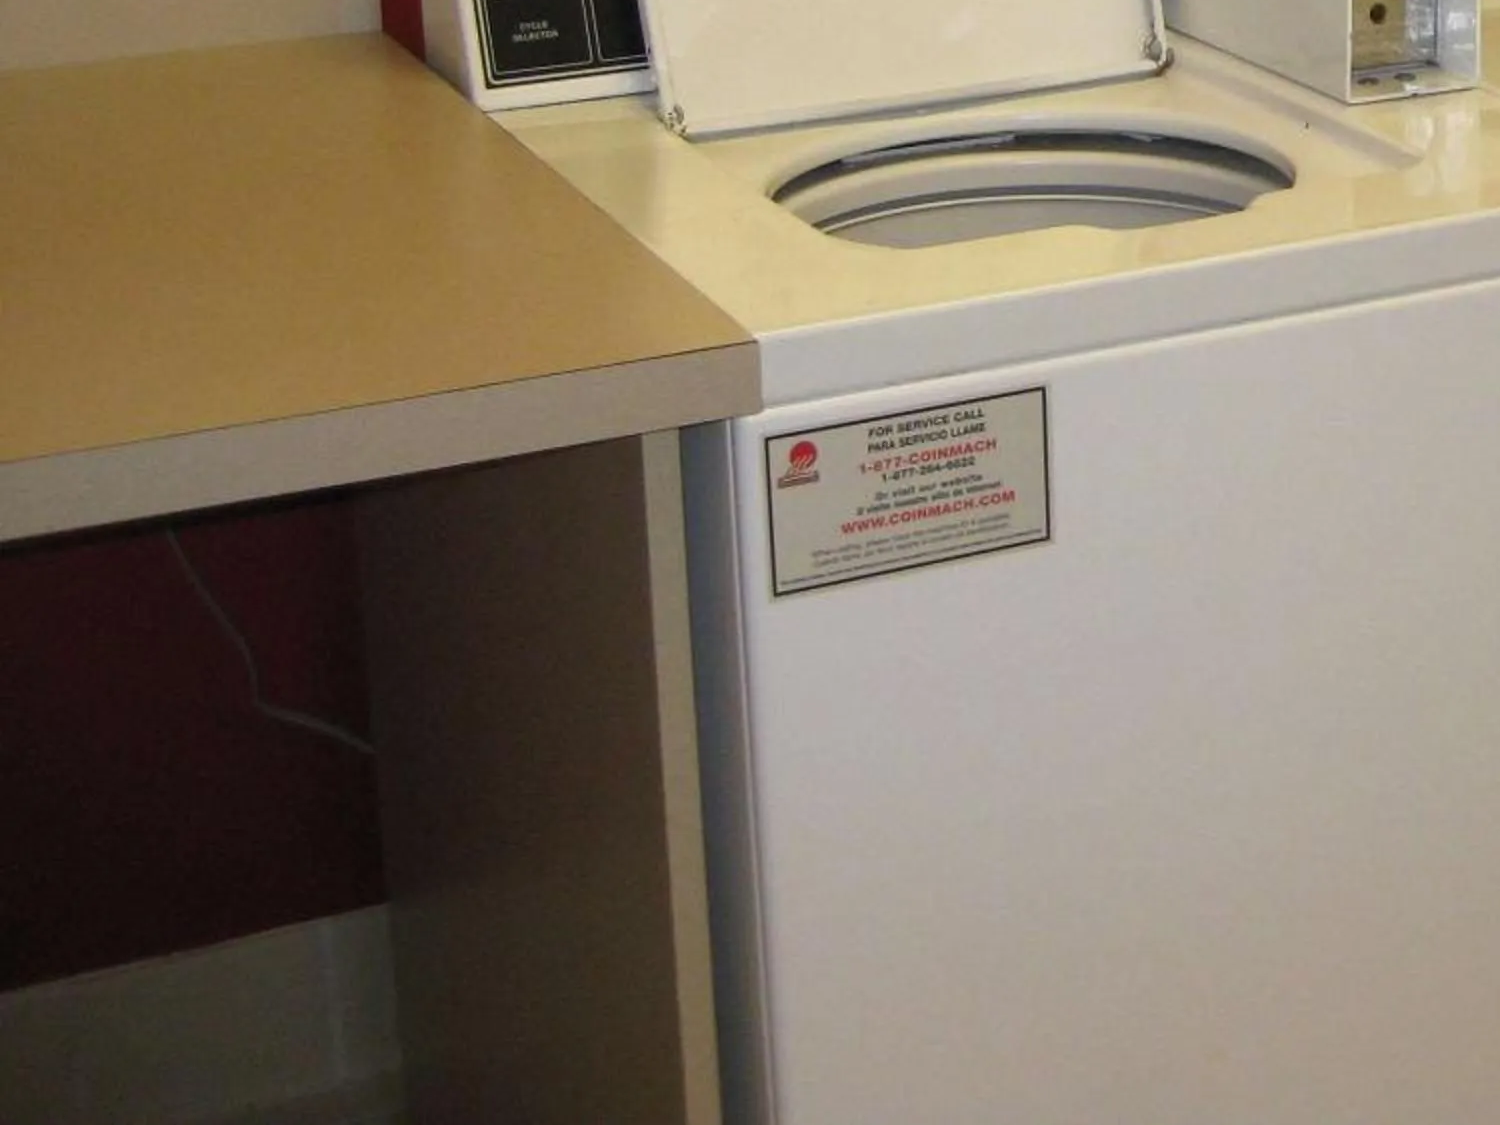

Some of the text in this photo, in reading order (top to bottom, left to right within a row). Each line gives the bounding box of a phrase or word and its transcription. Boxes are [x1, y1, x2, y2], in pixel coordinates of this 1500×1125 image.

[867, 407, 986, 440] FOR SERVICE CALL
[867, 421, 987, 454] PARA SERVICIO LLAME
[859, 438, 998, 475] 1-877-COINMACH
[841, 489, 1017, 535] WWW.COINMACH.COM
